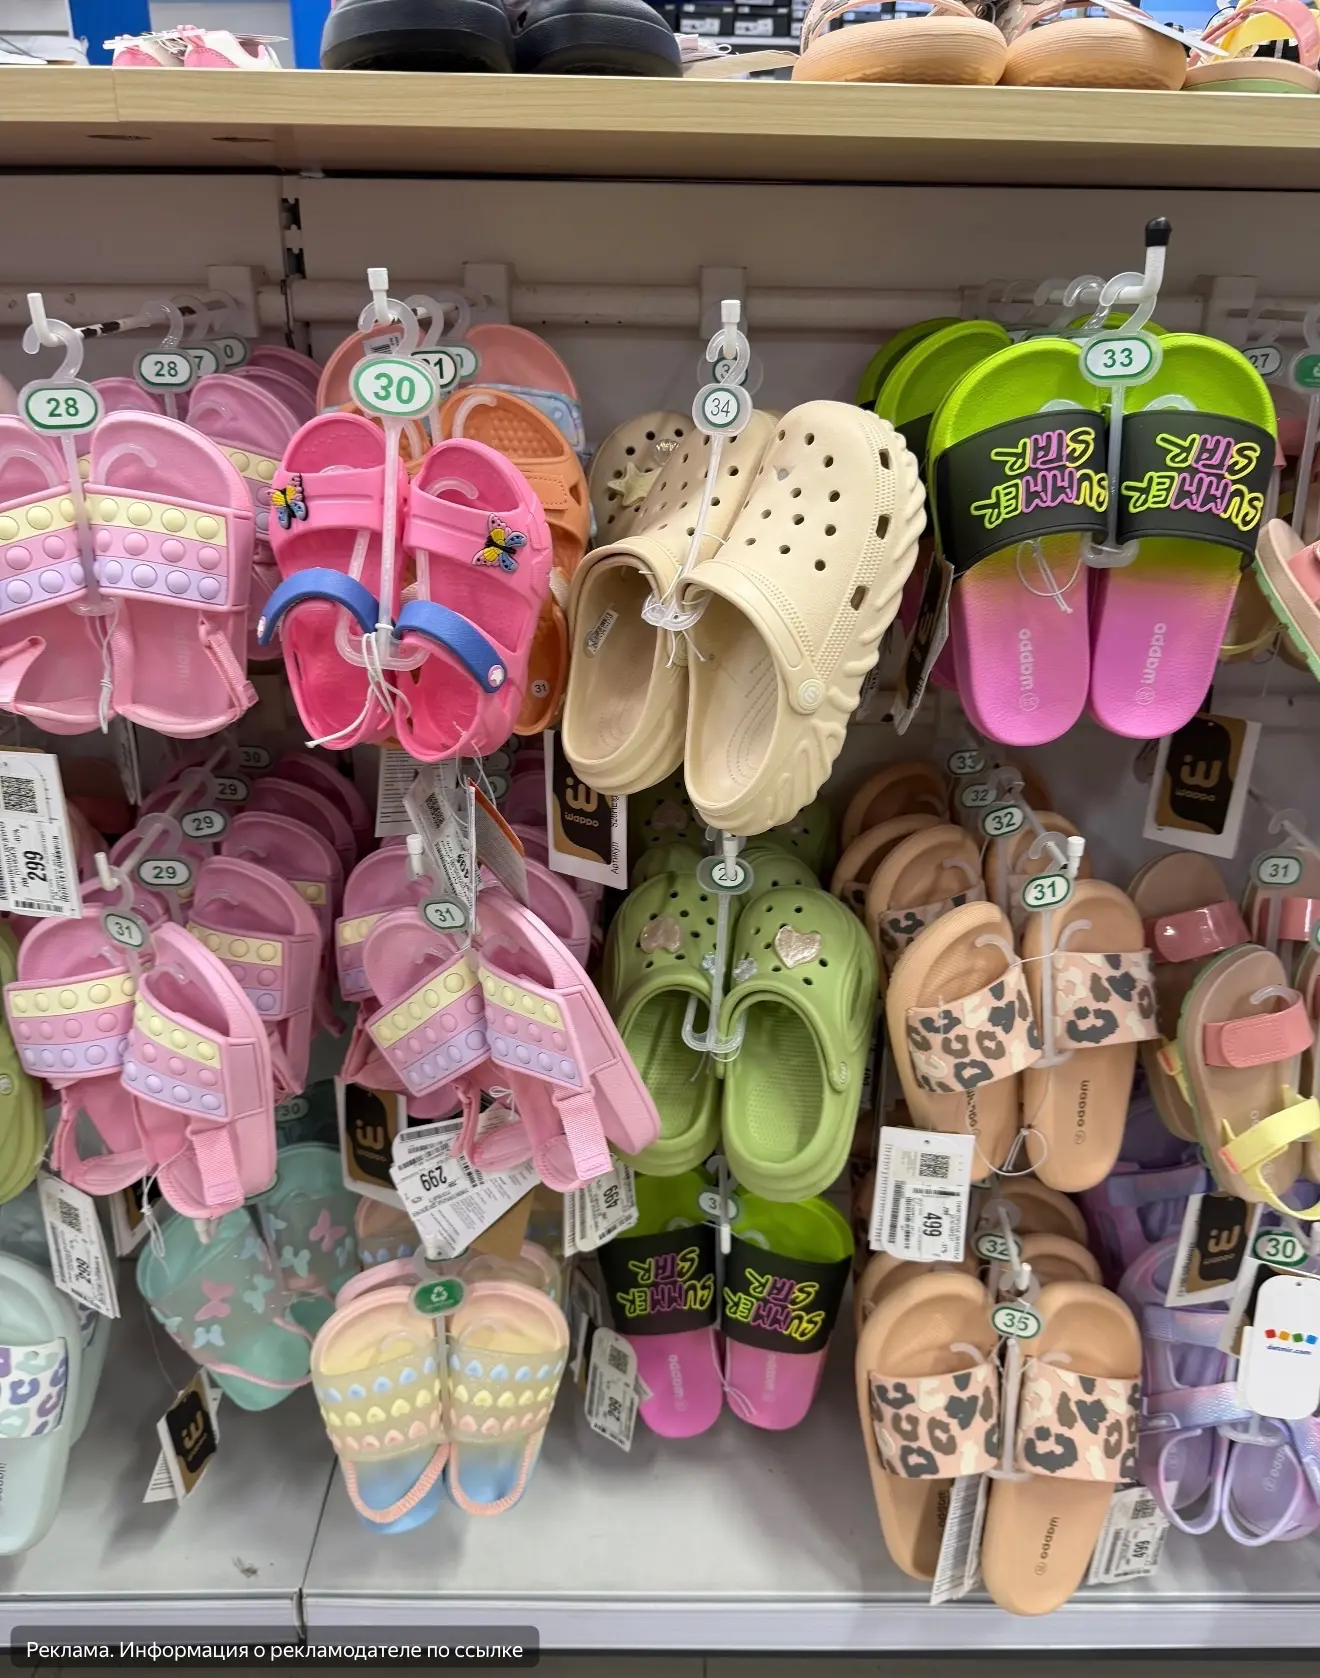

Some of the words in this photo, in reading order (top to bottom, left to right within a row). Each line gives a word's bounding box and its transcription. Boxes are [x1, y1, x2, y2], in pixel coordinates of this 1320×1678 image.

[153, 360, 179, 378] 28
[1102, 347, 1134, 369] 33
[1248, 353, 1271, 369] 27
[372, 371, 416, 405] 30
[46, 396, 80, 418] 28
[710, 397, 731, 418] 34
[991, 427, 1095, 476] STAR
[1155, 433, 1261, 480] STAR
[971, 468, 1109, 530] SUMMER
[1121, 471, 1264, 532] SUMMER
[1019, 628, 1035, 690] wappo
[1140, 622, 1167, 684] wappo
[534, 683, 547, 693] 31
[243, 751, 261, 763] 30
[218, 783, 238, 797] 29
[971, 789, 989, 802] 32
[192, 816, 214, 831] 29
[564, 811, 600, 828] wappo
[992, 812, 1015, 831] 32
[23, 850, 49, 882] 299
[153, 866, 177, 879] 29
[1269, 863, 1289, 878] 31
[1034, 880, 1057, 901] 31
[434, 906, 456, 923] 31
[113, 921, 134, 939] 31
[281, 1102, 300, 1116] 30
[1076, 1080, 1091, 1127] wappo
[419, 1165, 447, 1192] 299
[603, 1184, 619, 1208] 499
[922, 1211, 943, 1237] 499
[985, 1239, 1010, 1257] 32
[1265, 1238, 1296, 1259] 30
[75, 1257, 92, 1285] 299
[628, 1247, 699, 1283] STAR
[617, 1273, 715, 1318] SUMMER
[744, 1268, 819, 1309] STAR
[723, 1286, 826, 1341] SUMMER
[1002, 1312, 1031, 1332] 35
[1040, 1516, 1061, 1560] wappo
